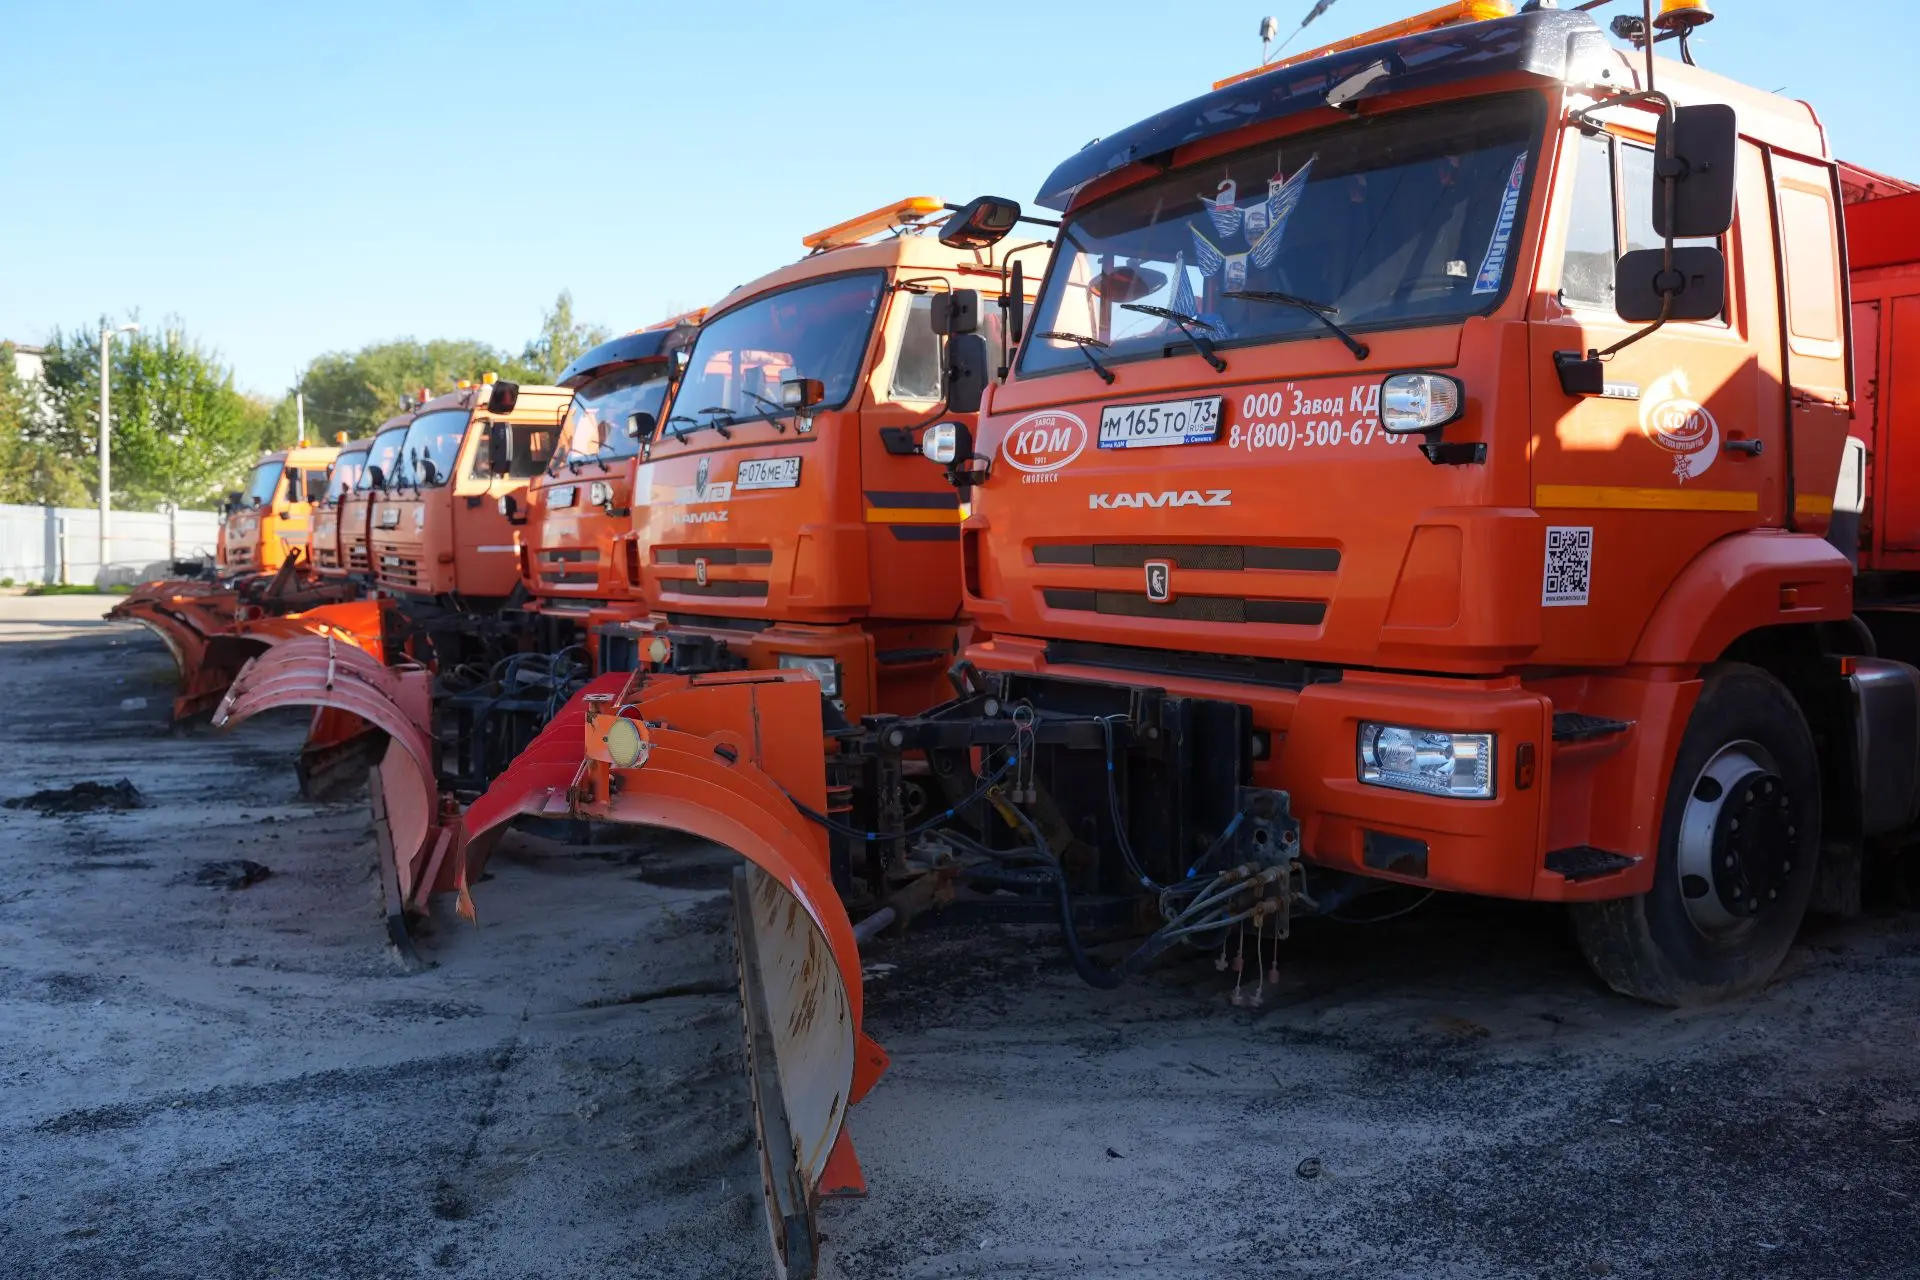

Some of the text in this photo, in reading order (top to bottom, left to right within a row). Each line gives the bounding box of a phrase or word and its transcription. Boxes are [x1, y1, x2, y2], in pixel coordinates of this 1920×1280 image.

[1243, 392, 1283, 419] ООО
[1349, 384, 1380, 417] КД
[1193, 401, 1212, 423] 73
[1662, 412, 1699, 430] KDM
[1190, 424, 1204, 432] RUS
[1015, 427, 1072, 455] KDM
[784, 459, 796, 474] 73
[1089, 489, 1232, 509] KAMAZ
